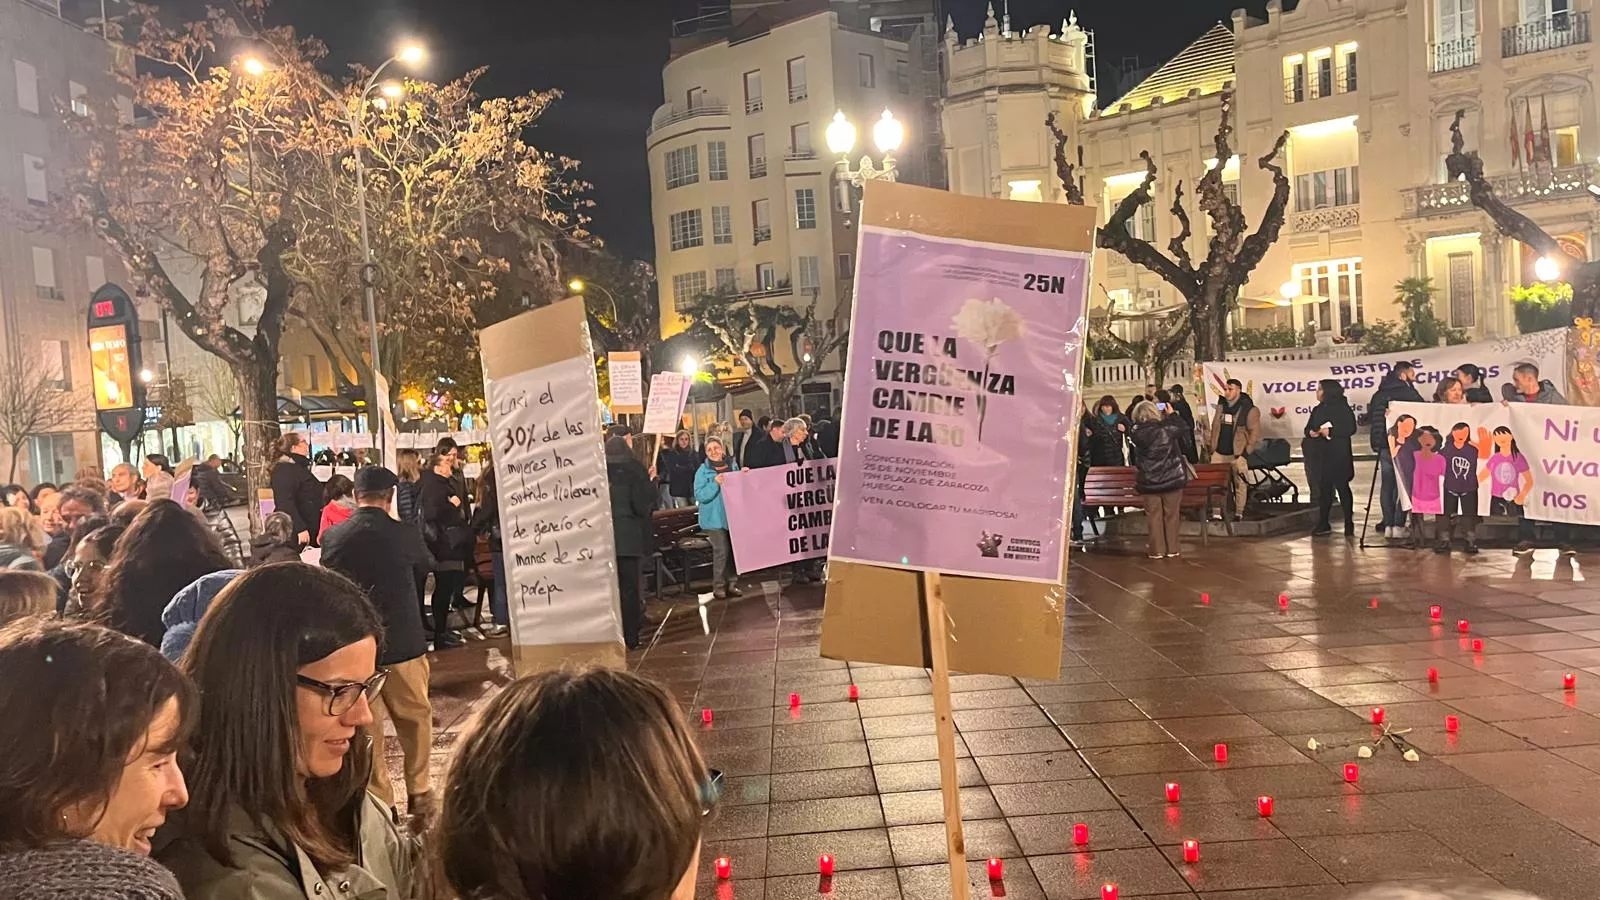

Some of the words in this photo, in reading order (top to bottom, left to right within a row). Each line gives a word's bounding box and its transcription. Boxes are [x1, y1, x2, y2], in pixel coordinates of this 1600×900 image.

[1023, 273, 1065, 294] 25N
[877, 330, 925, 354] QUE
[1330, 362, 1392, 376] BASTA
[539, 382, 554, 405] el
[503, 423, 536, 455] 30%
[541, 420, 561, 443] de
[565, 417, 584, 436] las
[869, 417, 900, 440] DE
[1544, 417, 1579, 442] Ni
[507, 456, 547, 479] mujeres
[553, 448, 574, 469] ha
[863, 464, 877, 472] 25
[877, 465, 893, 473] DE
[895, 466, 957, 480] NOVIEMBRE
[1542, 454, 1599, 477] viva
[786, 467, 814, 488] QUE
[818, 465, 836, 482] LA
[862, 482, 905, 492] HUESCA
[883, 474, 917, 485] PLAZA
[919, 477, 934, 487] DE
[936, 480, 990, 493] ZARAGOZA
[886, 497, 895, 506] A
[896, 499, 946, 511] COLOCAR
[1542, 490, 1587, 510] nos
[512, 514, 529, 539] de
[578, 518, 593, 529] a
[515, 551, 547, 567] manos
[553, 540, 572, 564] de
[577, 547, 594, 562] su
[789, 536, 809, 555] DE
[812, 534, 829, 551] LA
[520, 576, 564, 610] pareja
